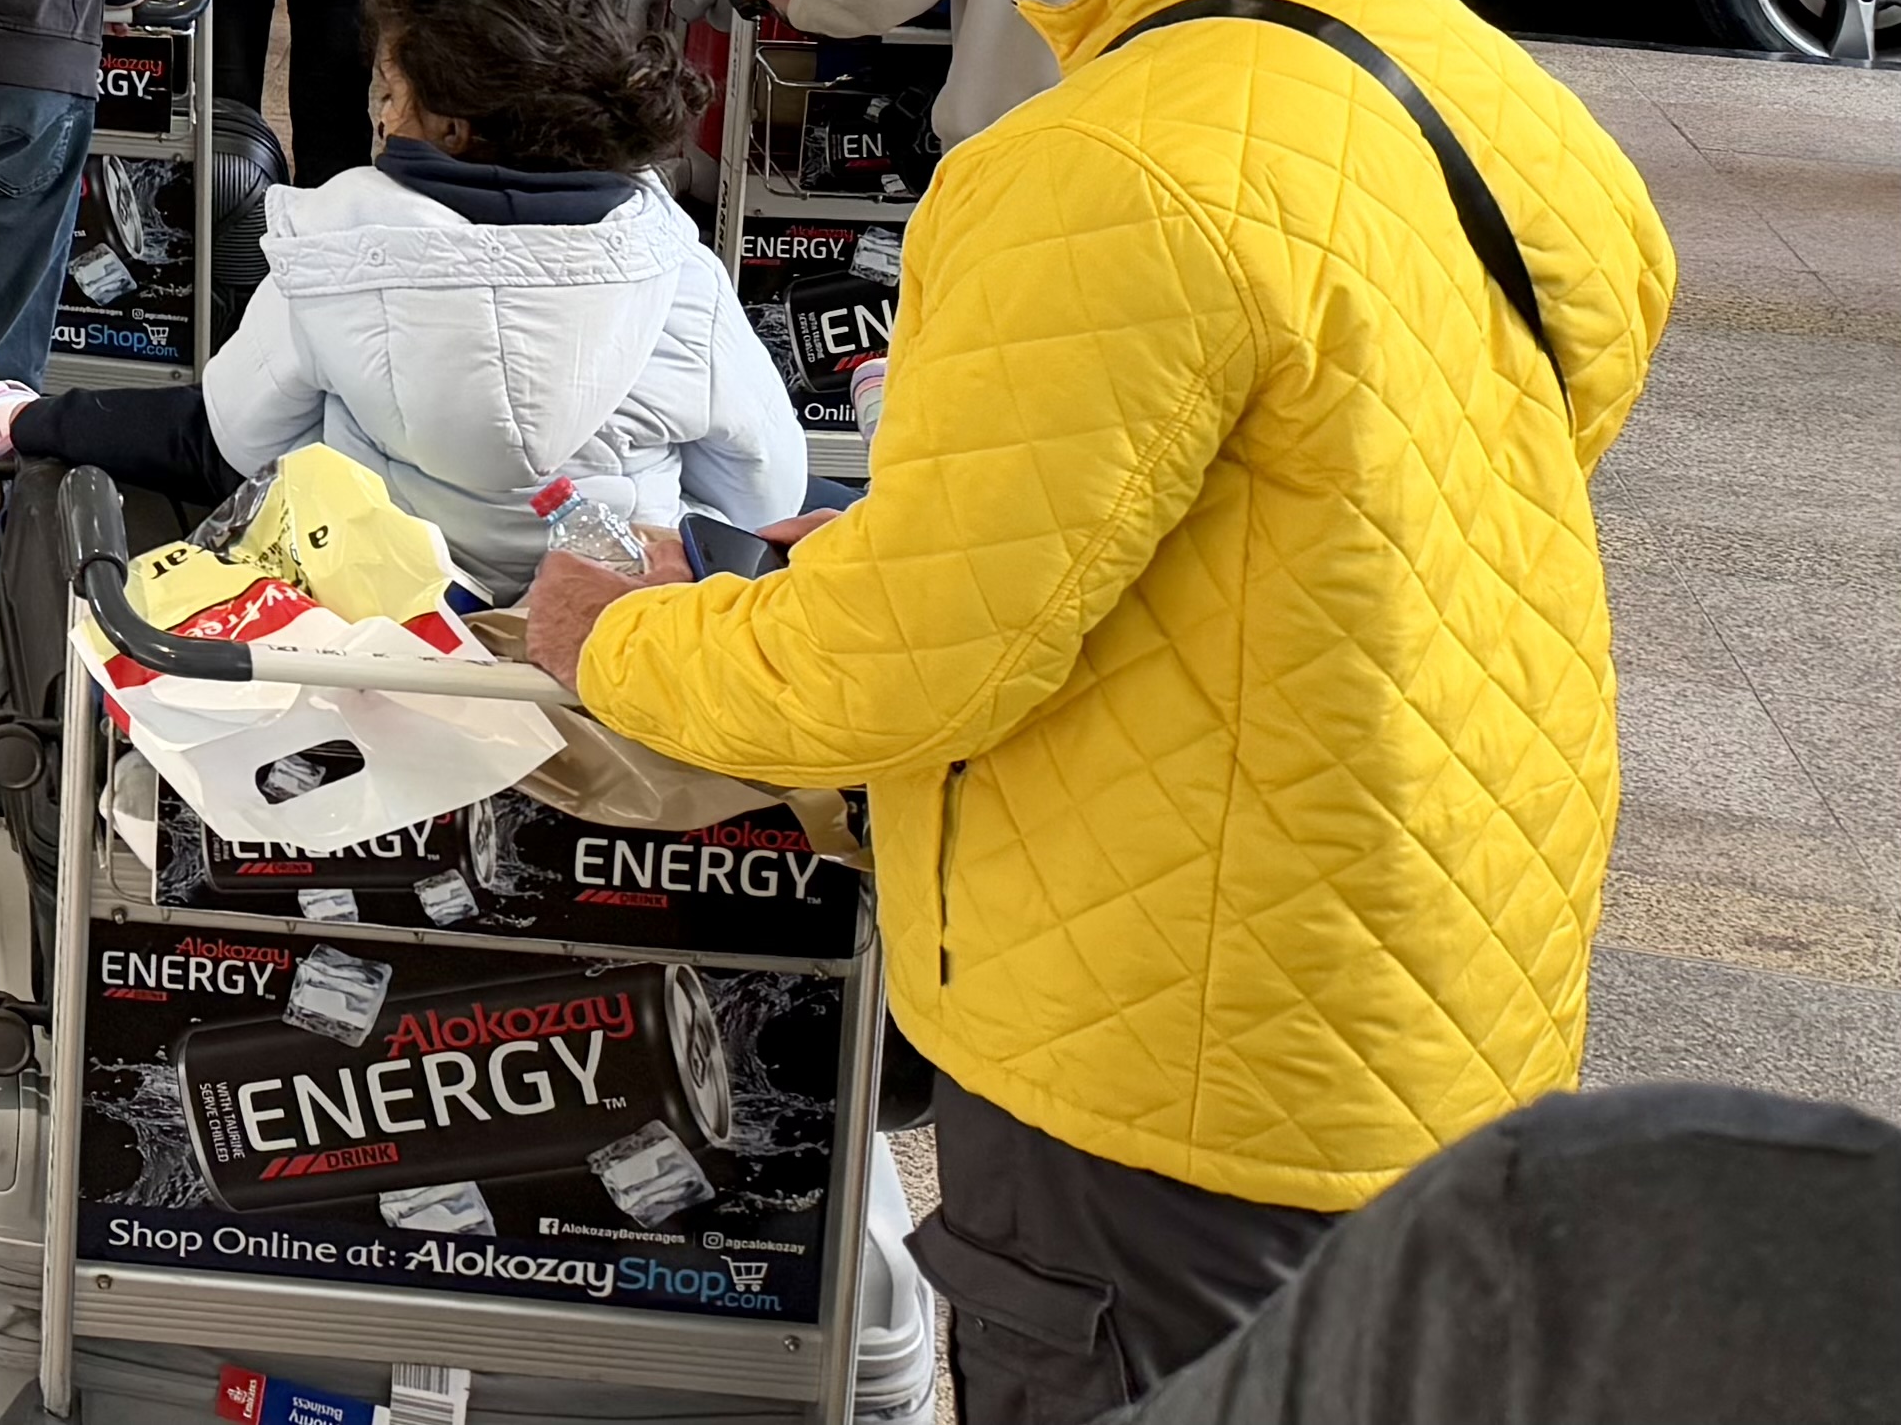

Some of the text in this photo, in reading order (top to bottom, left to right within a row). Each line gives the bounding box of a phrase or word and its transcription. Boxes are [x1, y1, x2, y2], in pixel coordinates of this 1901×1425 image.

[101, 53, 162, 77] kozay
[96, 68, 151, 98] RGY
[741, 235, 845, 260] ENERGY
[804, 401, 855, 422] Onli
[681, 821, 812, 852] Alokoz
[574, 836, 821, 900] ENERGY
[175, 936, 289, 970] Alokozay
[101, 950, 275, 997] ENERGY
[383, 991, 636, 1059] Alokozay
[237, 1029, 605, 1152] ENERGY
[199, 1082, 230, 1163] SERVE CHILLED
[216, 1081, 246, 1159] WITH TAURINE
[325, 1143, 394, 1169] DRINK
[108, 1218, 203, 1258] Shop
[212, 1226, 338, 1264] Online
[561, 1222, 686, 1245] AlokozayBeverages
[724, 1238, 805, 1255] agcalokozay
[291, 1396, 344, 1422] Business
